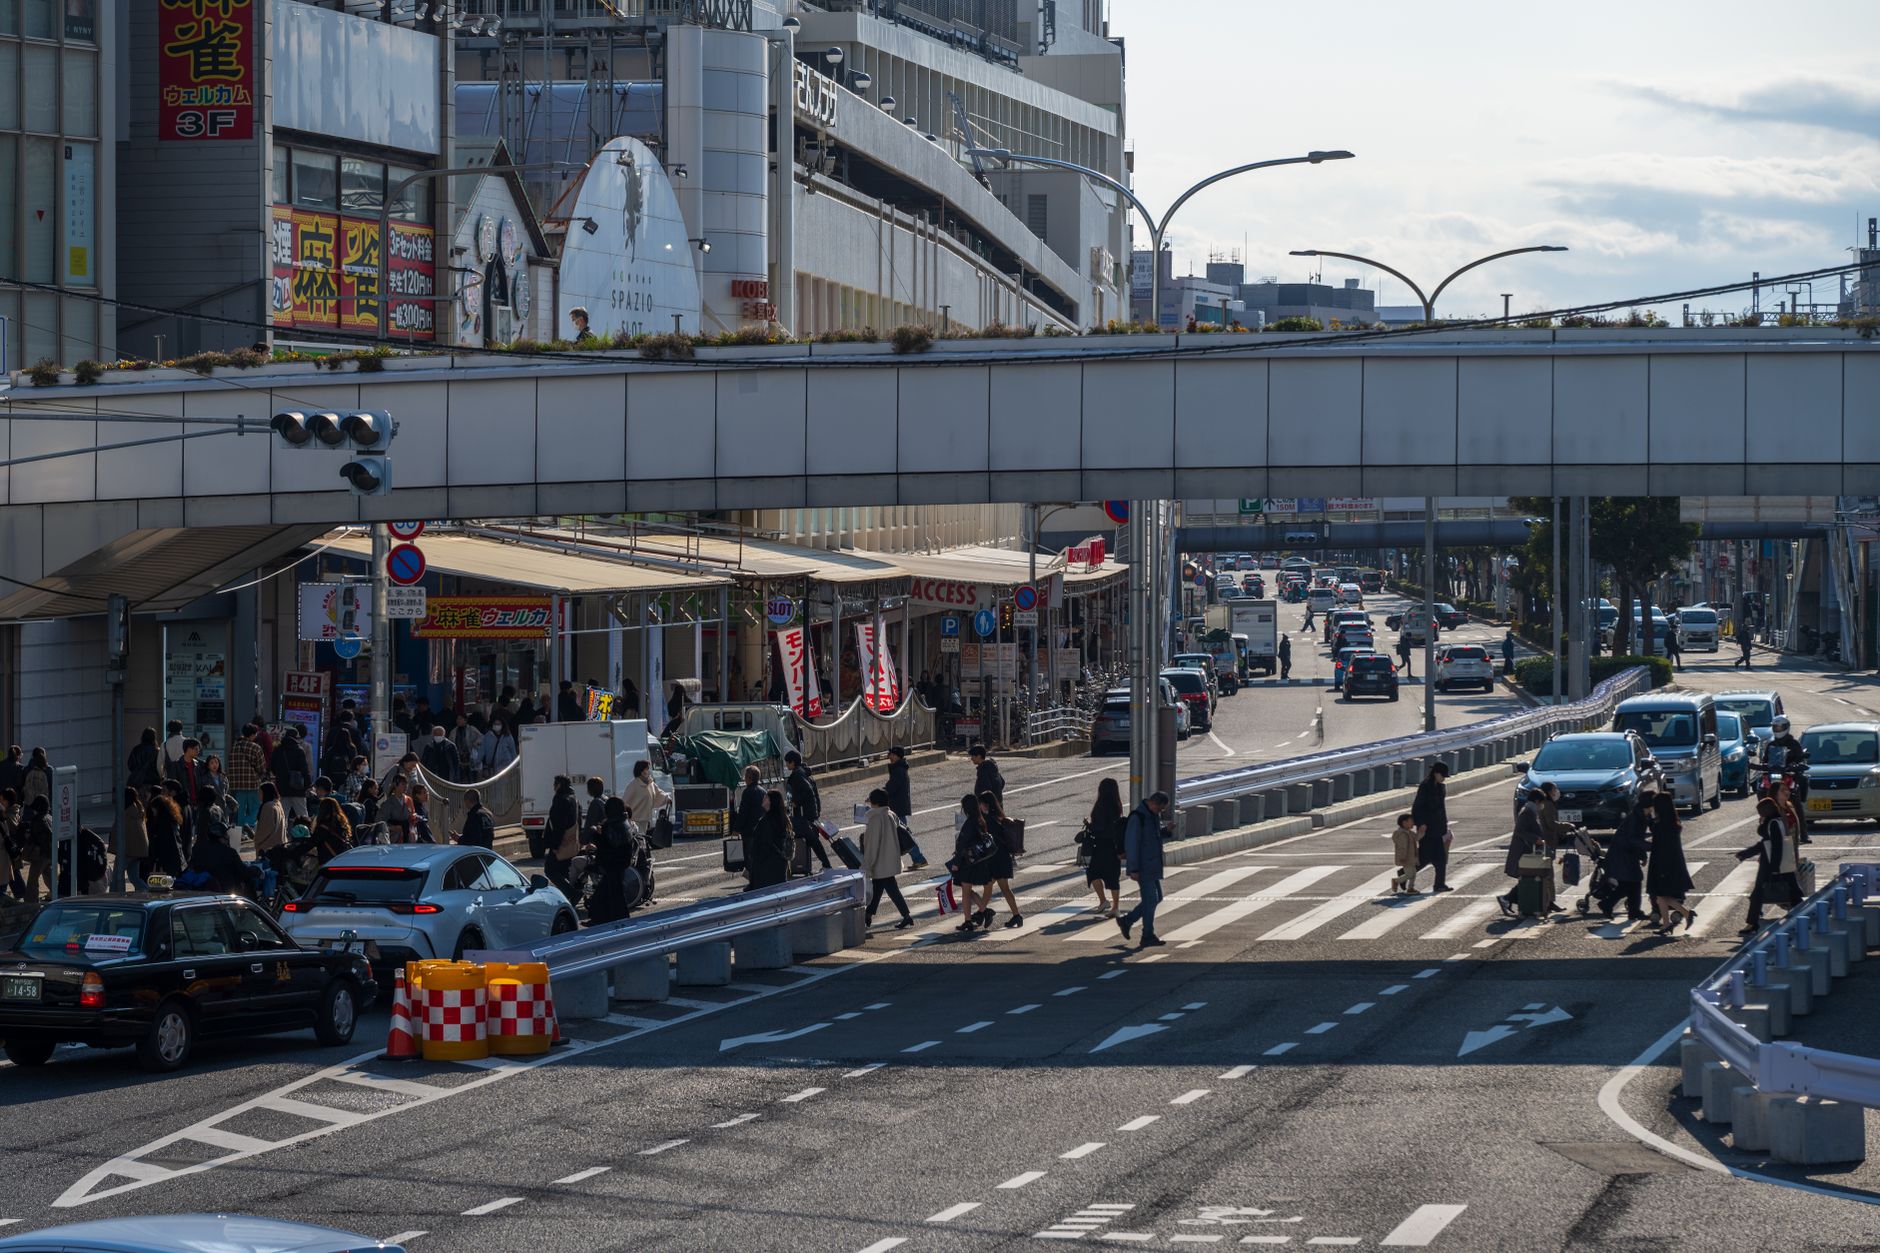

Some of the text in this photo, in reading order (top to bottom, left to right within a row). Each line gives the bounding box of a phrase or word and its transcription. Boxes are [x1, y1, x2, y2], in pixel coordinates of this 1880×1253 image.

[161, 0, 244, 82] 雀
[163, 84, 252, 107] ウェルカム
[176, 110, 237, 137] 3F
[389, 228, 433, 262] 3Fセット料金
[611, 289, 653, 313] SPAZIO
[911, 578, 977, 606] ACCESS
[389, 607, 423, 616] ここから
[767, 601, 793, 617] SLOT
[945, 618, 961, 634] P
[299, 676, 318, 693] 4F
[14, 985, 37, 998] 14-58
